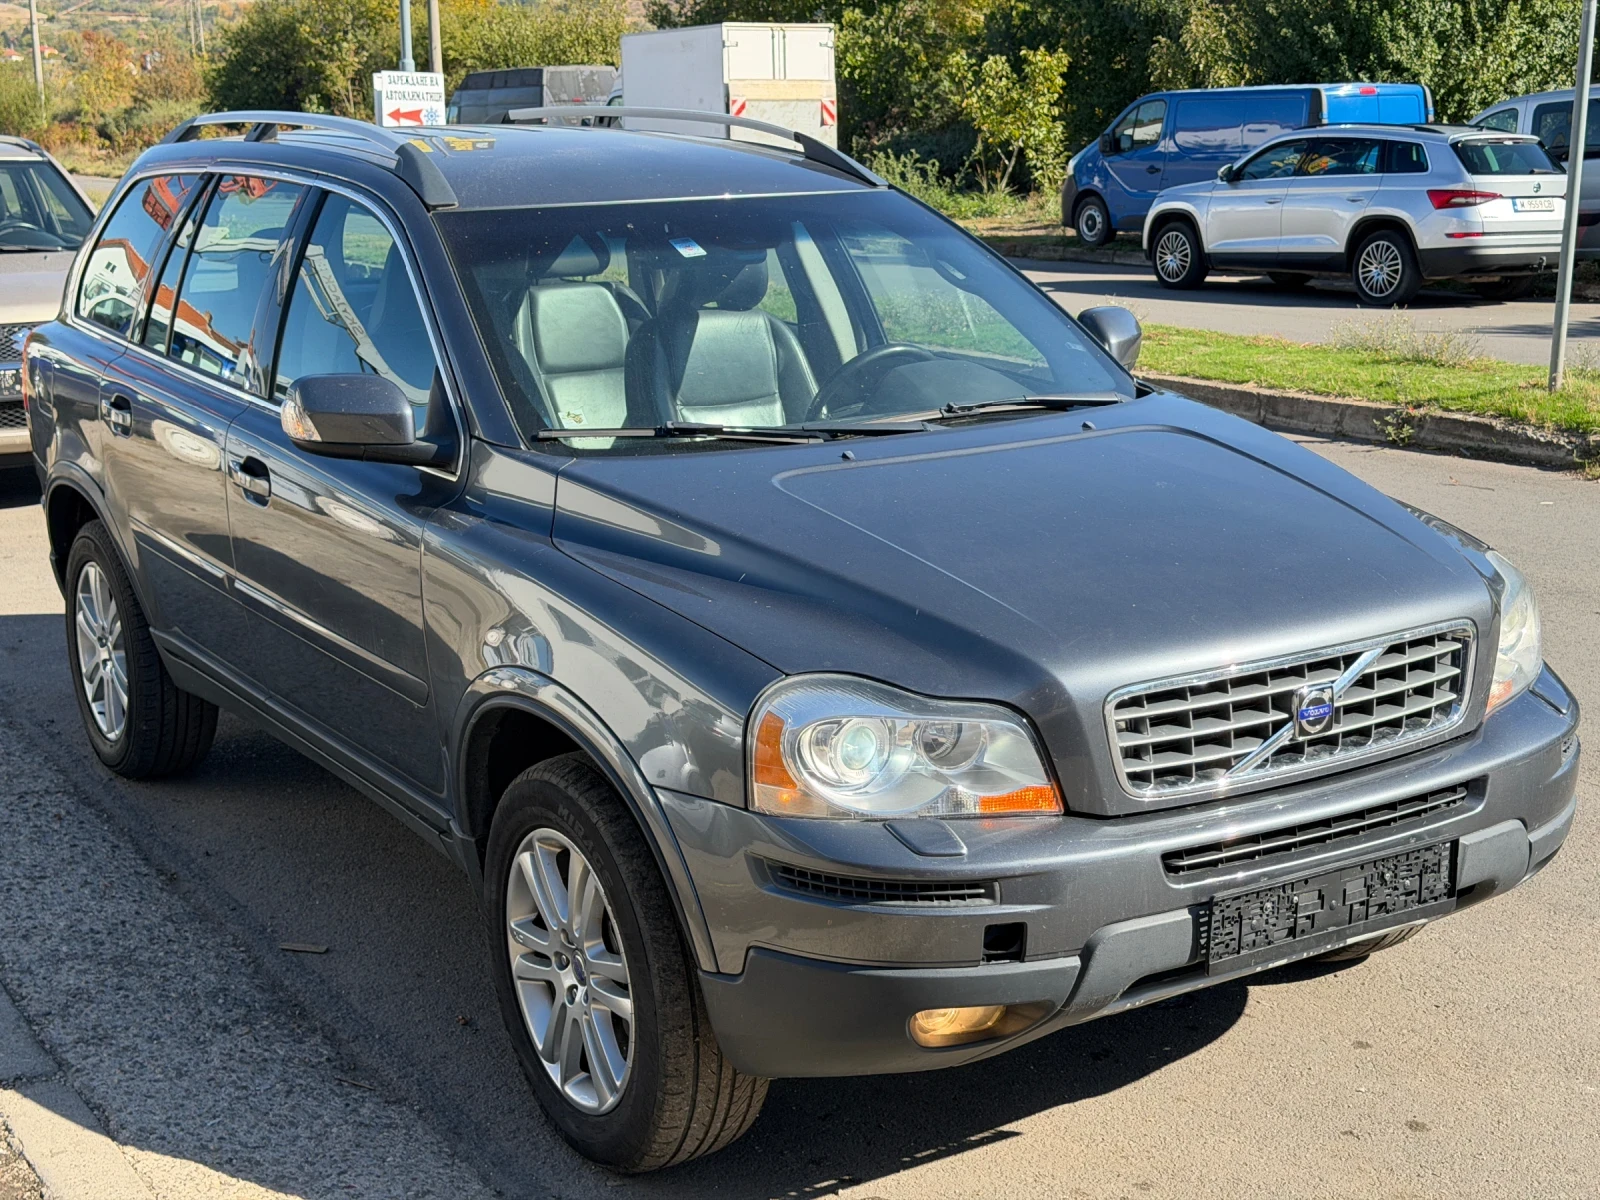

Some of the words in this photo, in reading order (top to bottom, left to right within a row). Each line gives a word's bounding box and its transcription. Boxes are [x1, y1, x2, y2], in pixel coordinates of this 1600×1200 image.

[387, 74, 428, 86] ЗАРЕЖДАНЕ
[429, 76, 439, 87] НА
[1302, 707, 1330, 717] VOLVO
[557, 804, 614, 888] MIRAGE
